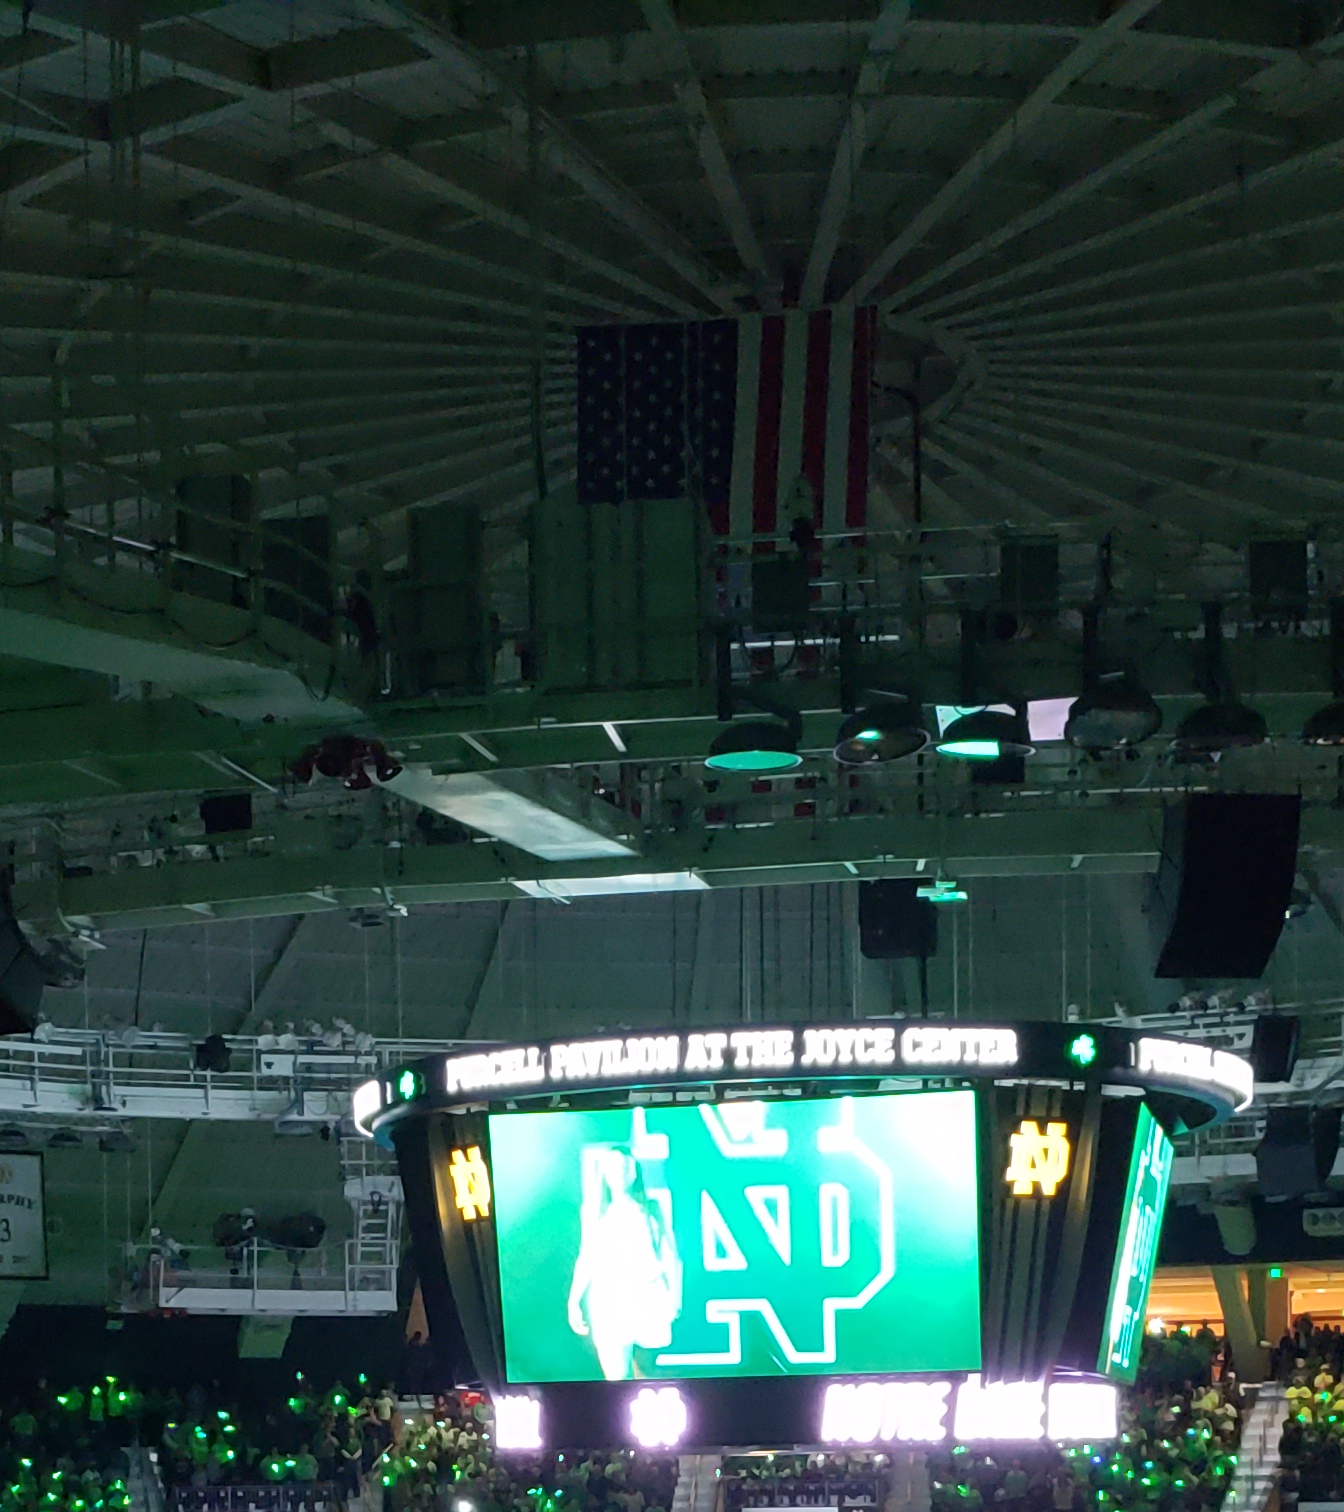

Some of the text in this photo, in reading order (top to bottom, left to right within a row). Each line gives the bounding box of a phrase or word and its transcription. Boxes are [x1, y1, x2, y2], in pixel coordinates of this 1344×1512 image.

[446, 1028, 1019, 1094] PURCELL PAVILION AT THE JOYCE CENTER
